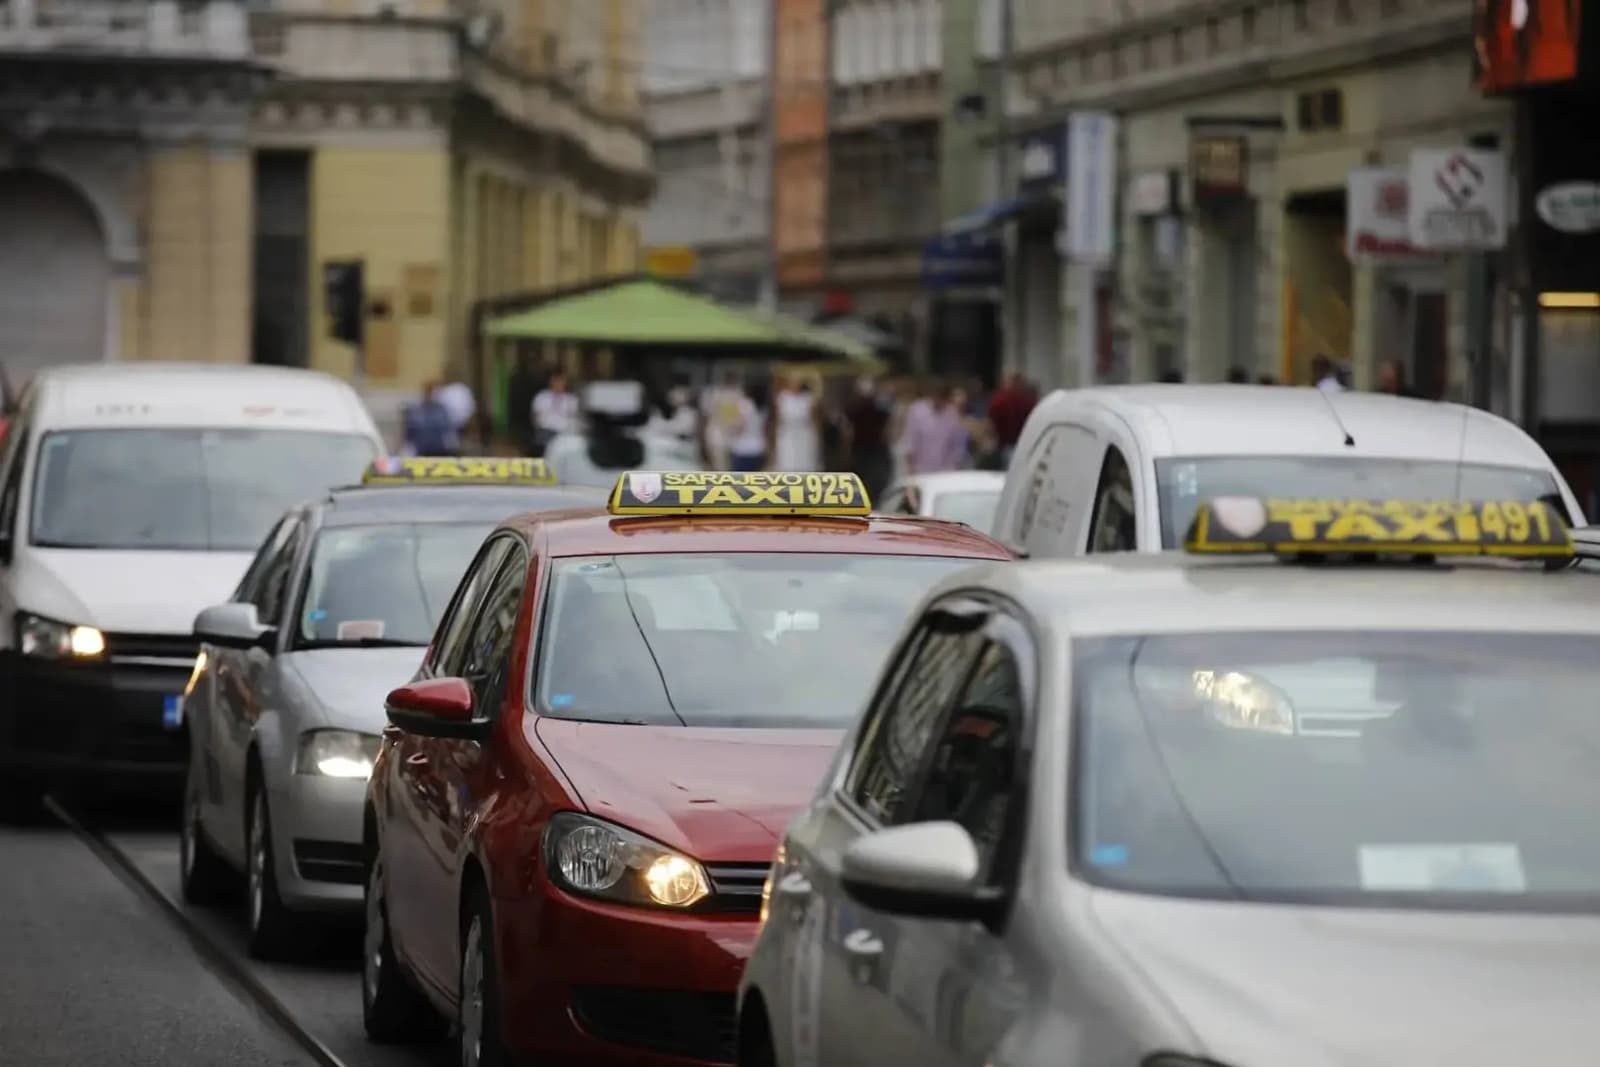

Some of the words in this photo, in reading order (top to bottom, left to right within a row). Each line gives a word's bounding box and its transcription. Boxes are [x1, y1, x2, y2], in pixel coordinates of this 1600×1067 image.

[403, 461, 508, 477] TAXI
[664, 473, 802, 485] SARAJEVO
[665, 485, 804, 504] TAXI
[806, 474, 854, 504] 925
[1267, 511, 1480, 541] TAXI
[1480, 501, 1551, 542] 491
